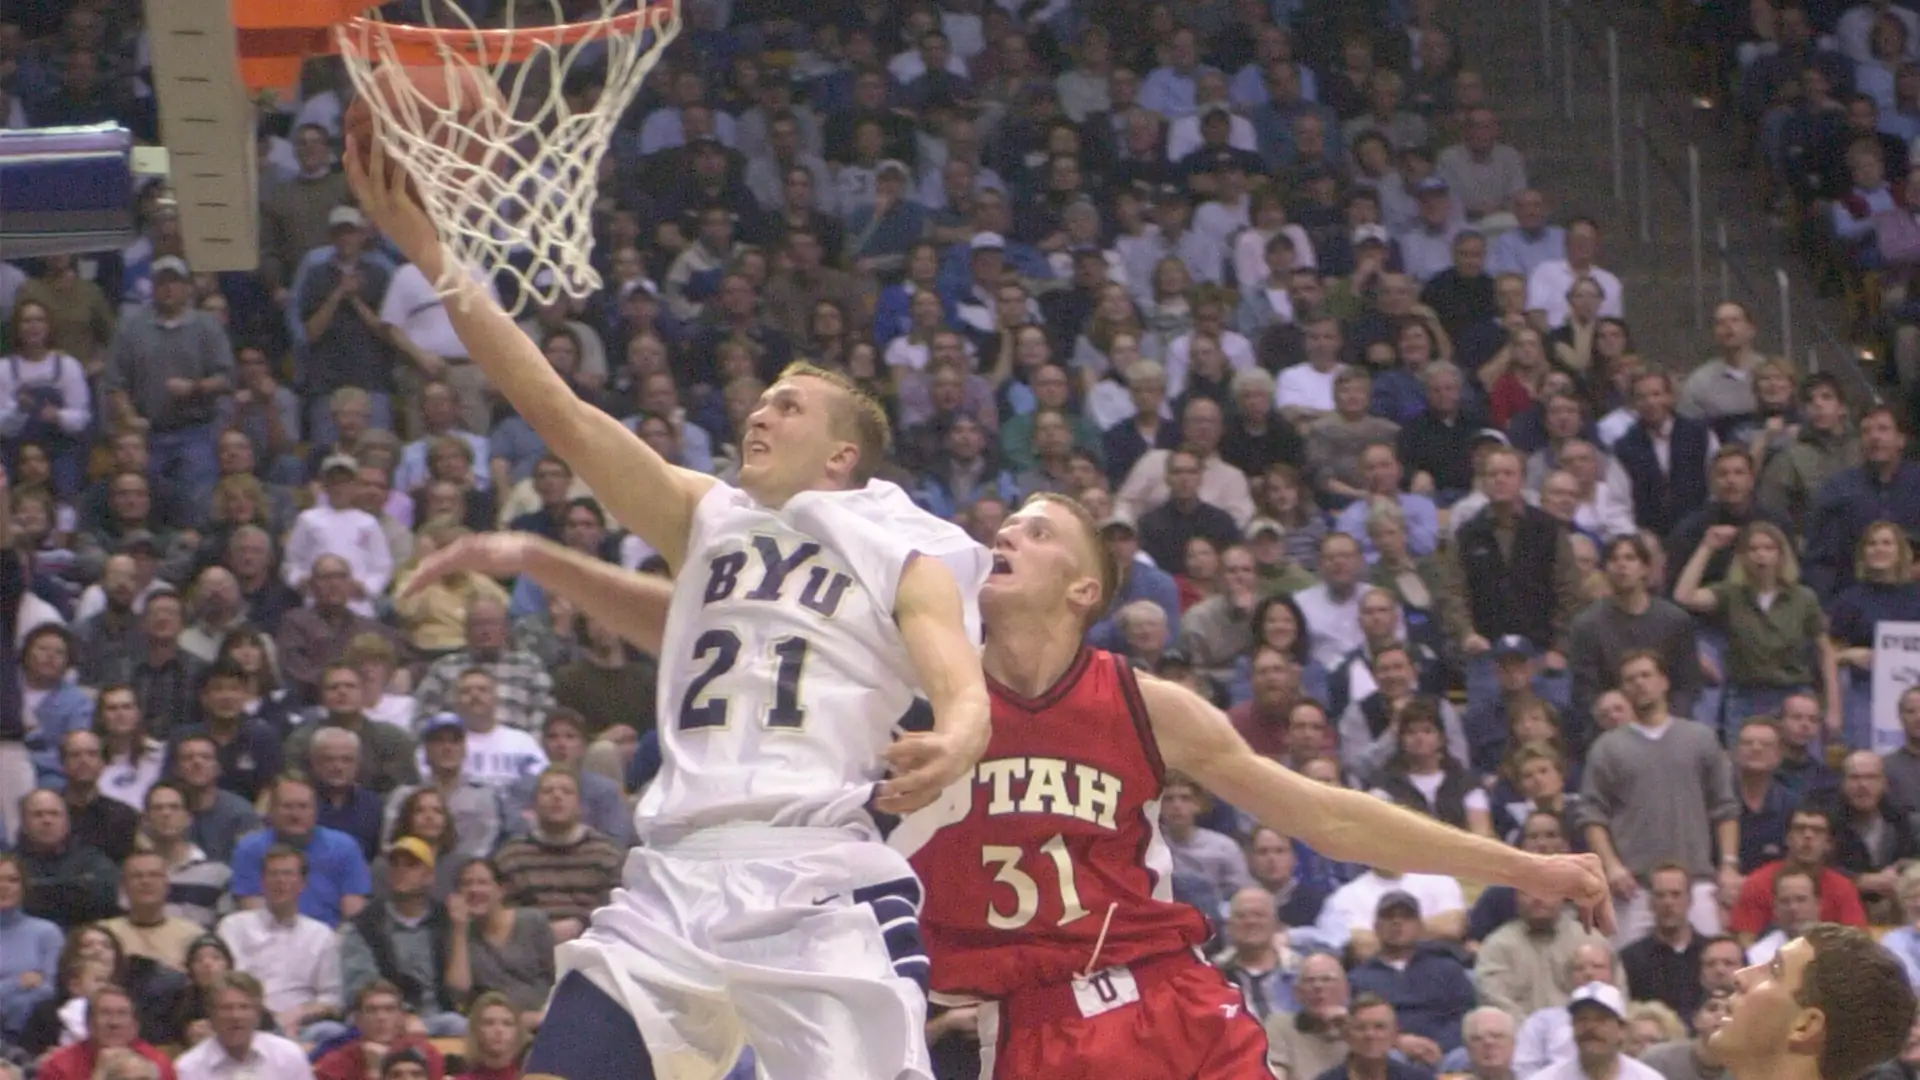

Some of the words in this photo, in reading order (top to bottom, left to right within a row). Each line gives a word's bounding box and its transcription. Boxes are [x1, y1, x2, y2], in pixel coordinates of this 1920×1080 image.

[704, 535, 853, 617] BYU
[679, 629, 807, 731] 21
[982, 833, 1090, 930] 31
[1088, 970, 1118, 1003] U
